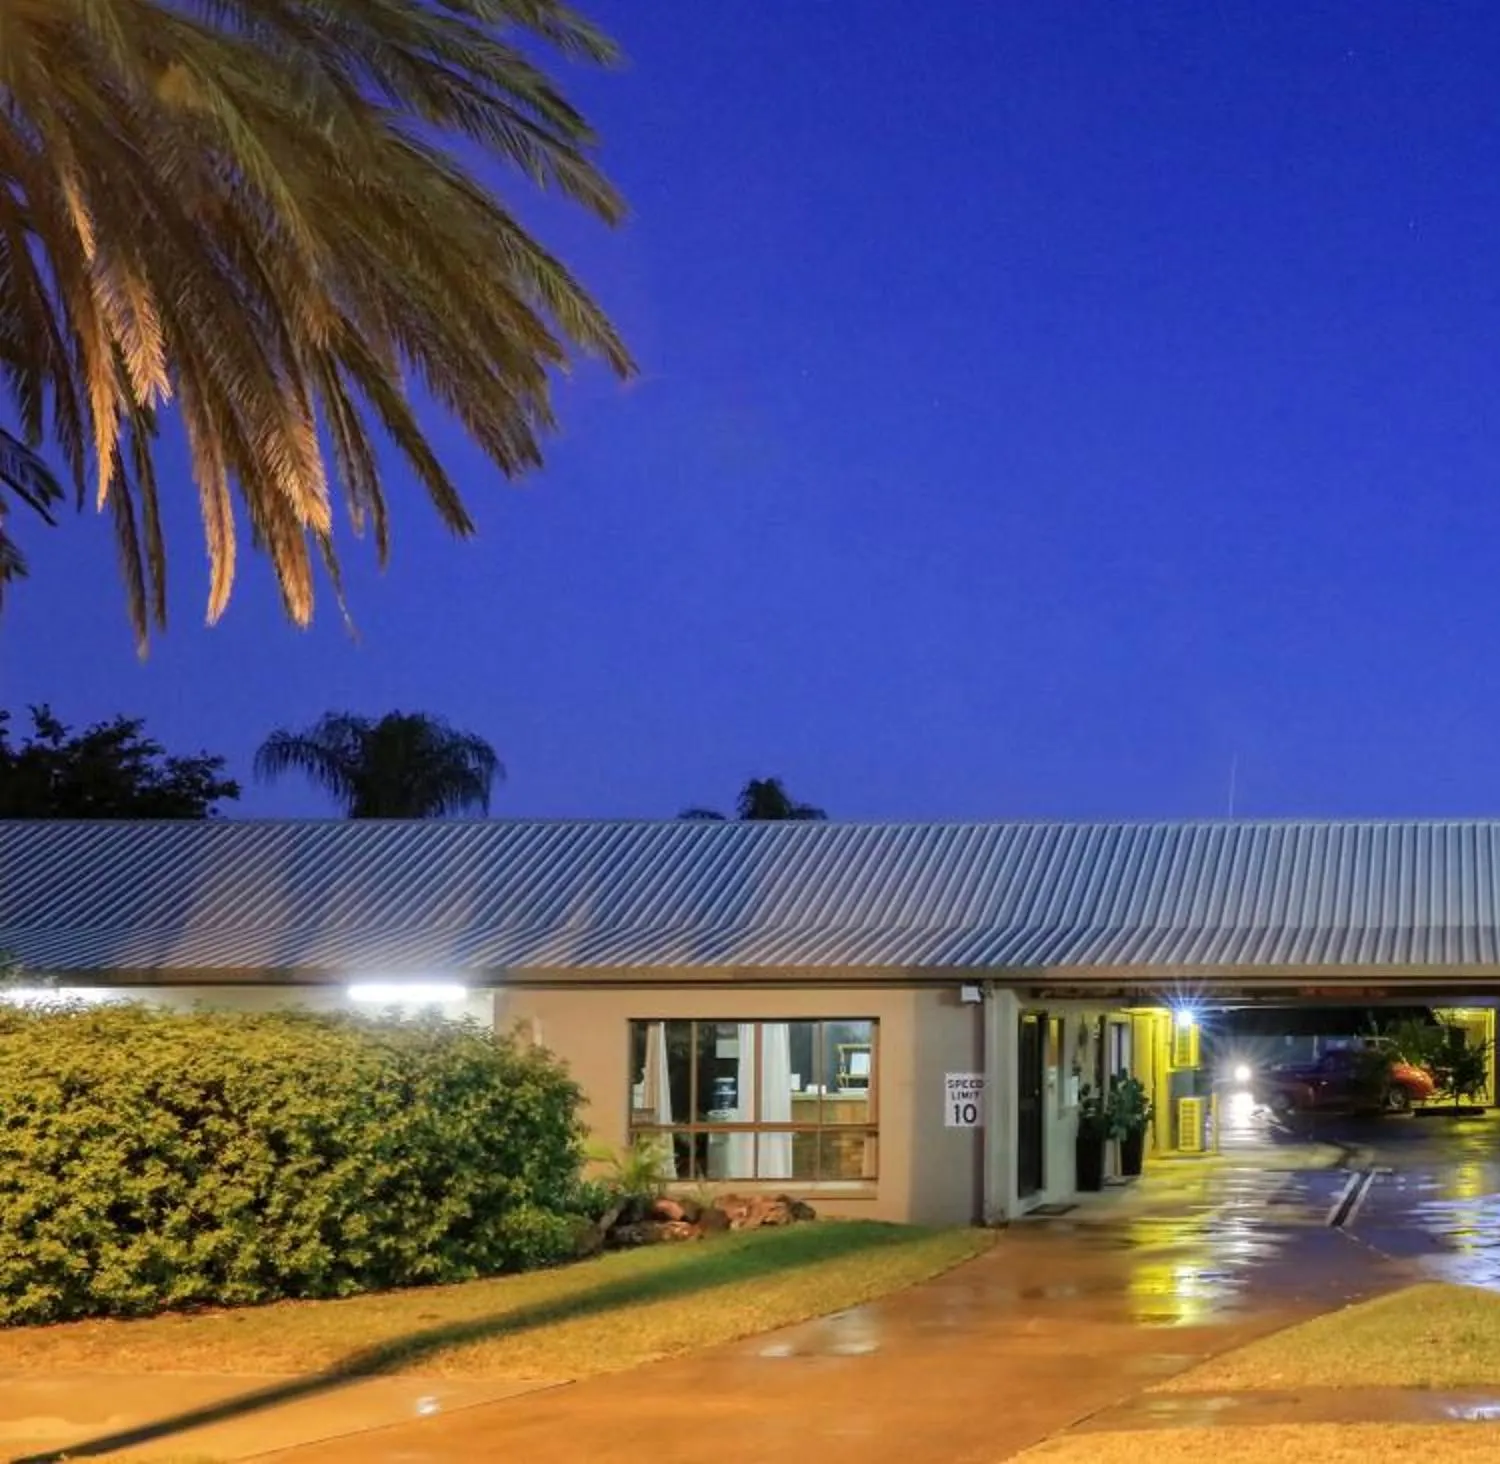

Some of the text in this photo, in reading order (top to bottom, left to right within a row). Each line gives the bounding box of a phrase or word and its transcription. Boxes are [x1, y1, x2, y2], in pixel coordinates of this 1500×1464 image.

[947, 1079, 985, 1089] SPEED
[951, 1091, 980, 1101] LIMIT
[953, 1103, 977, 1124] 10
